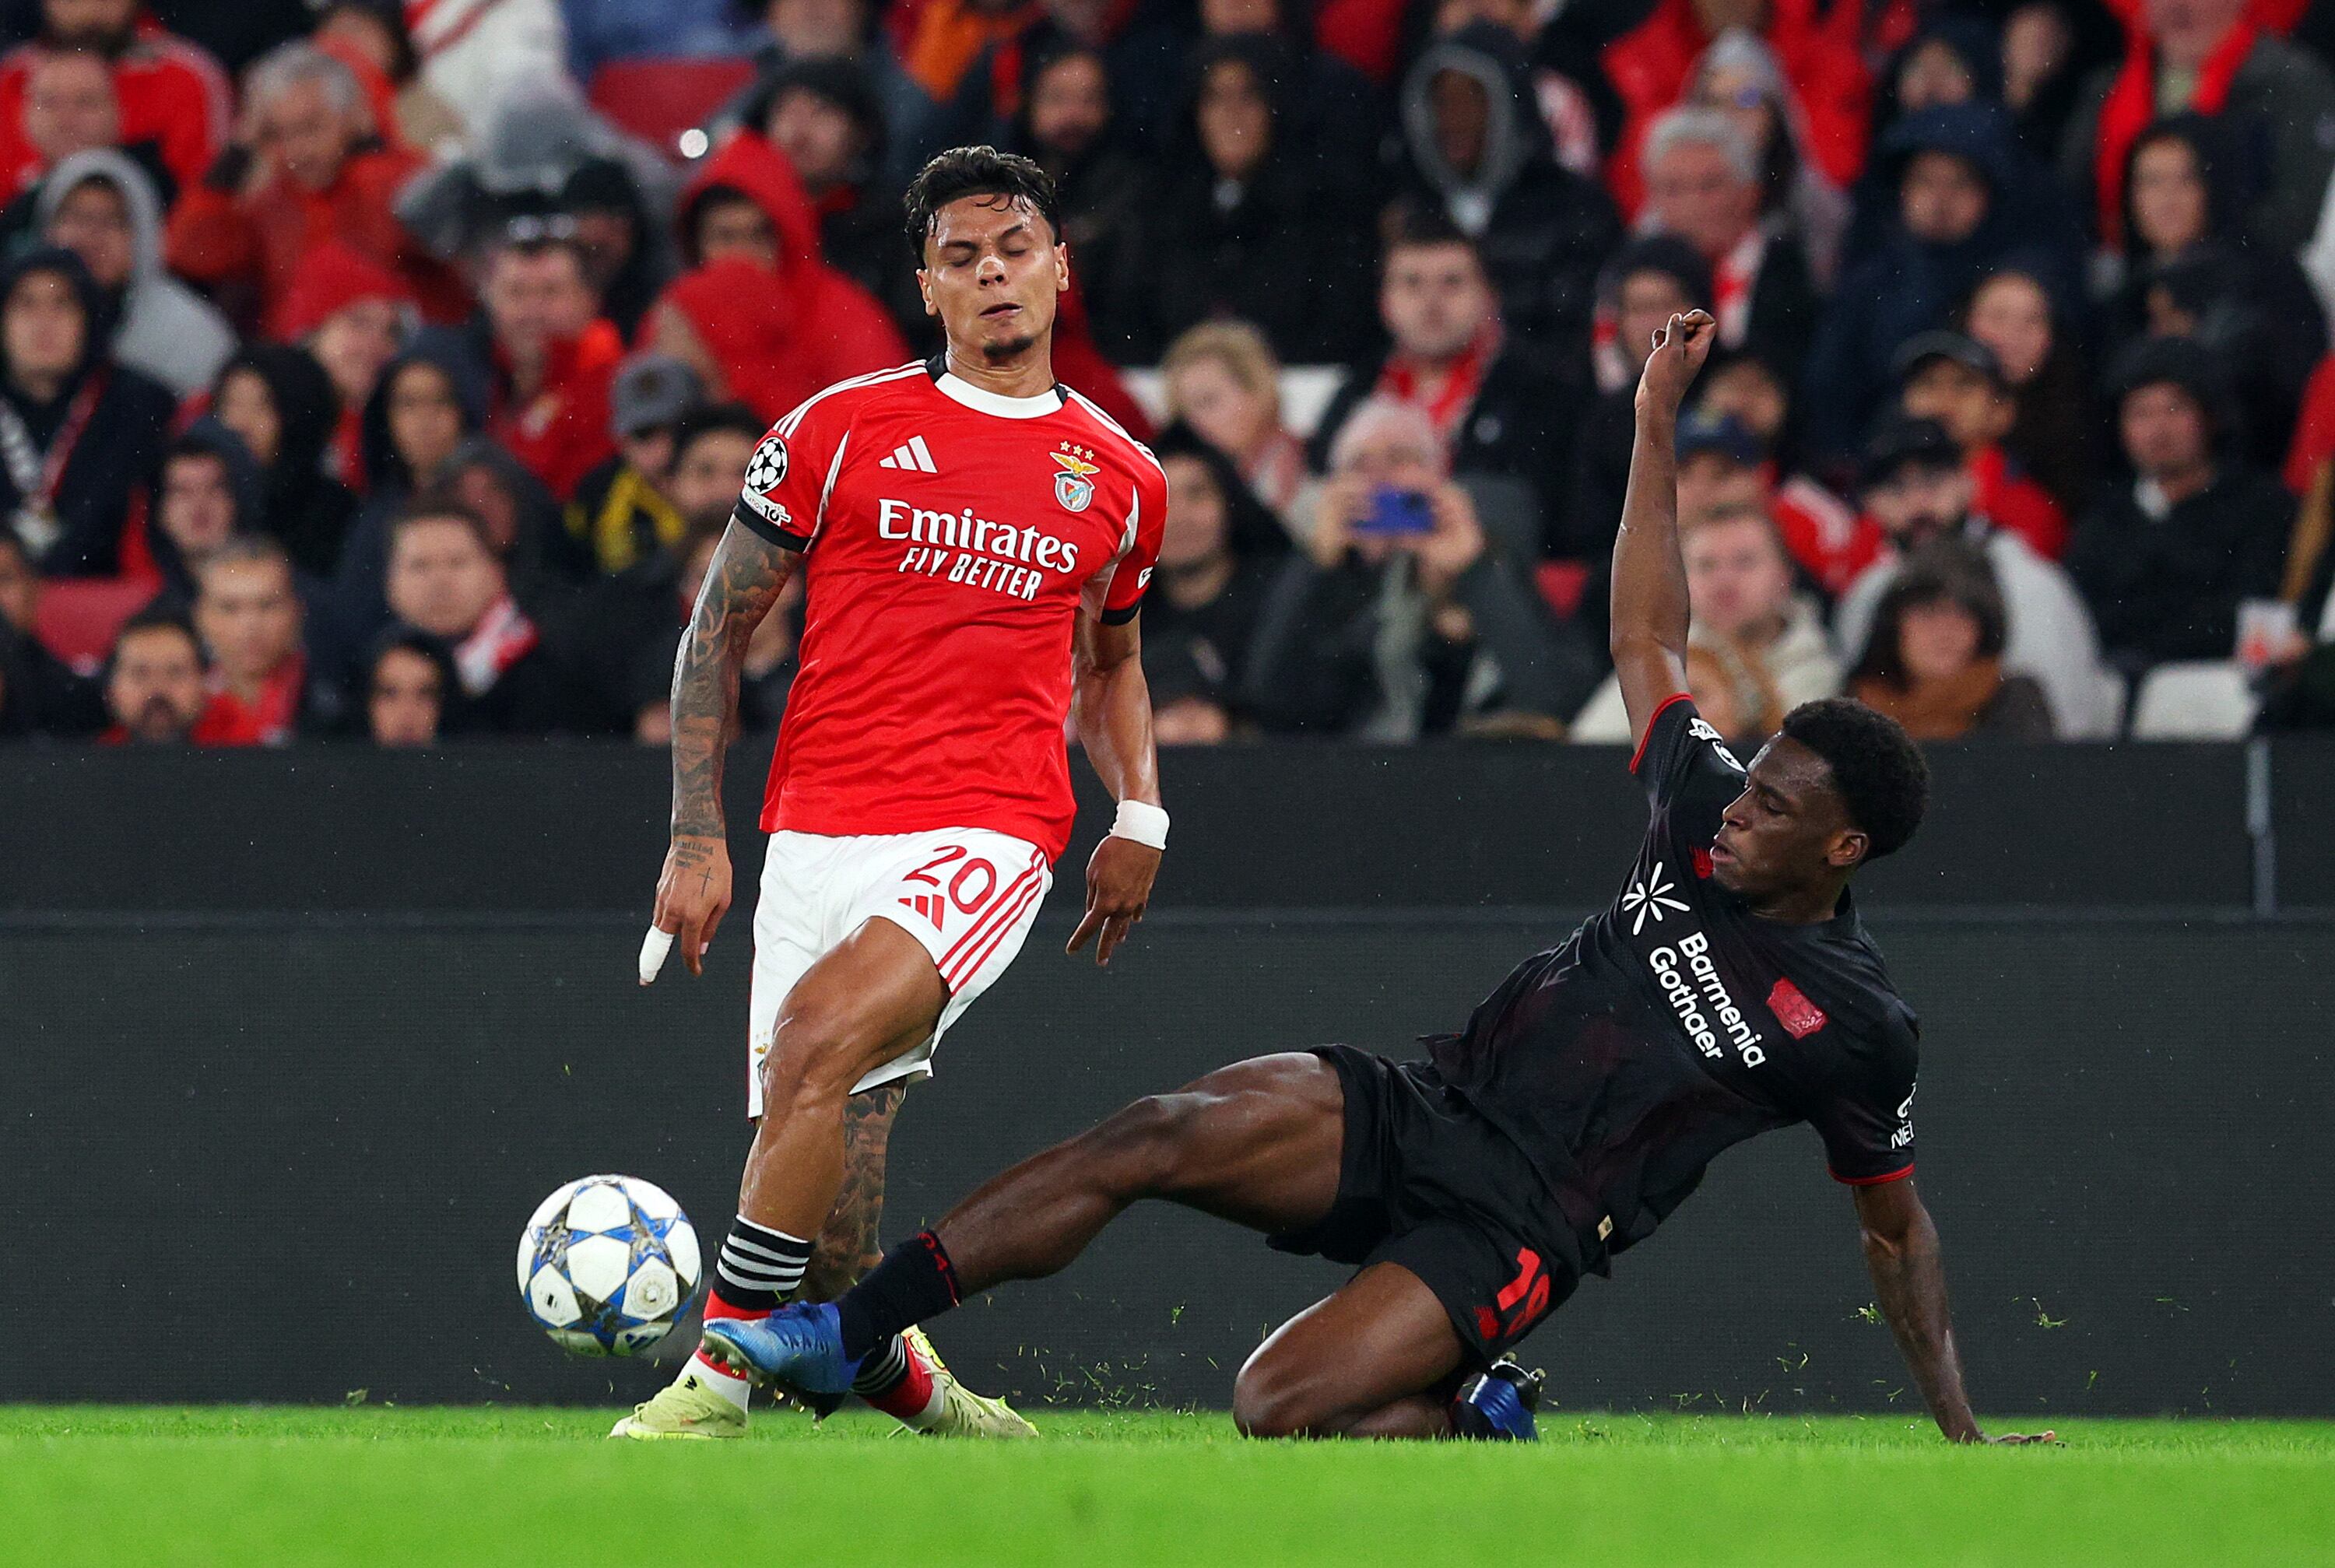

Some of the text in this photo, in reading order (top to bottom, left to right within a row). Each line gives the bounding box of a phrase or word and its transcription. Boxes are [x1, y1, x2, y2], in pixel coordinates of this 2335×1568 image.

[879, 499, 1079, 574] Emirates
[898, 547, 1042, 602] FLY BETTER
[903, 845, 997, 915] 20
[1649, 946, 1723, 1061] Gothaer
[1677, 931, 1766, 1068] Barmenia
